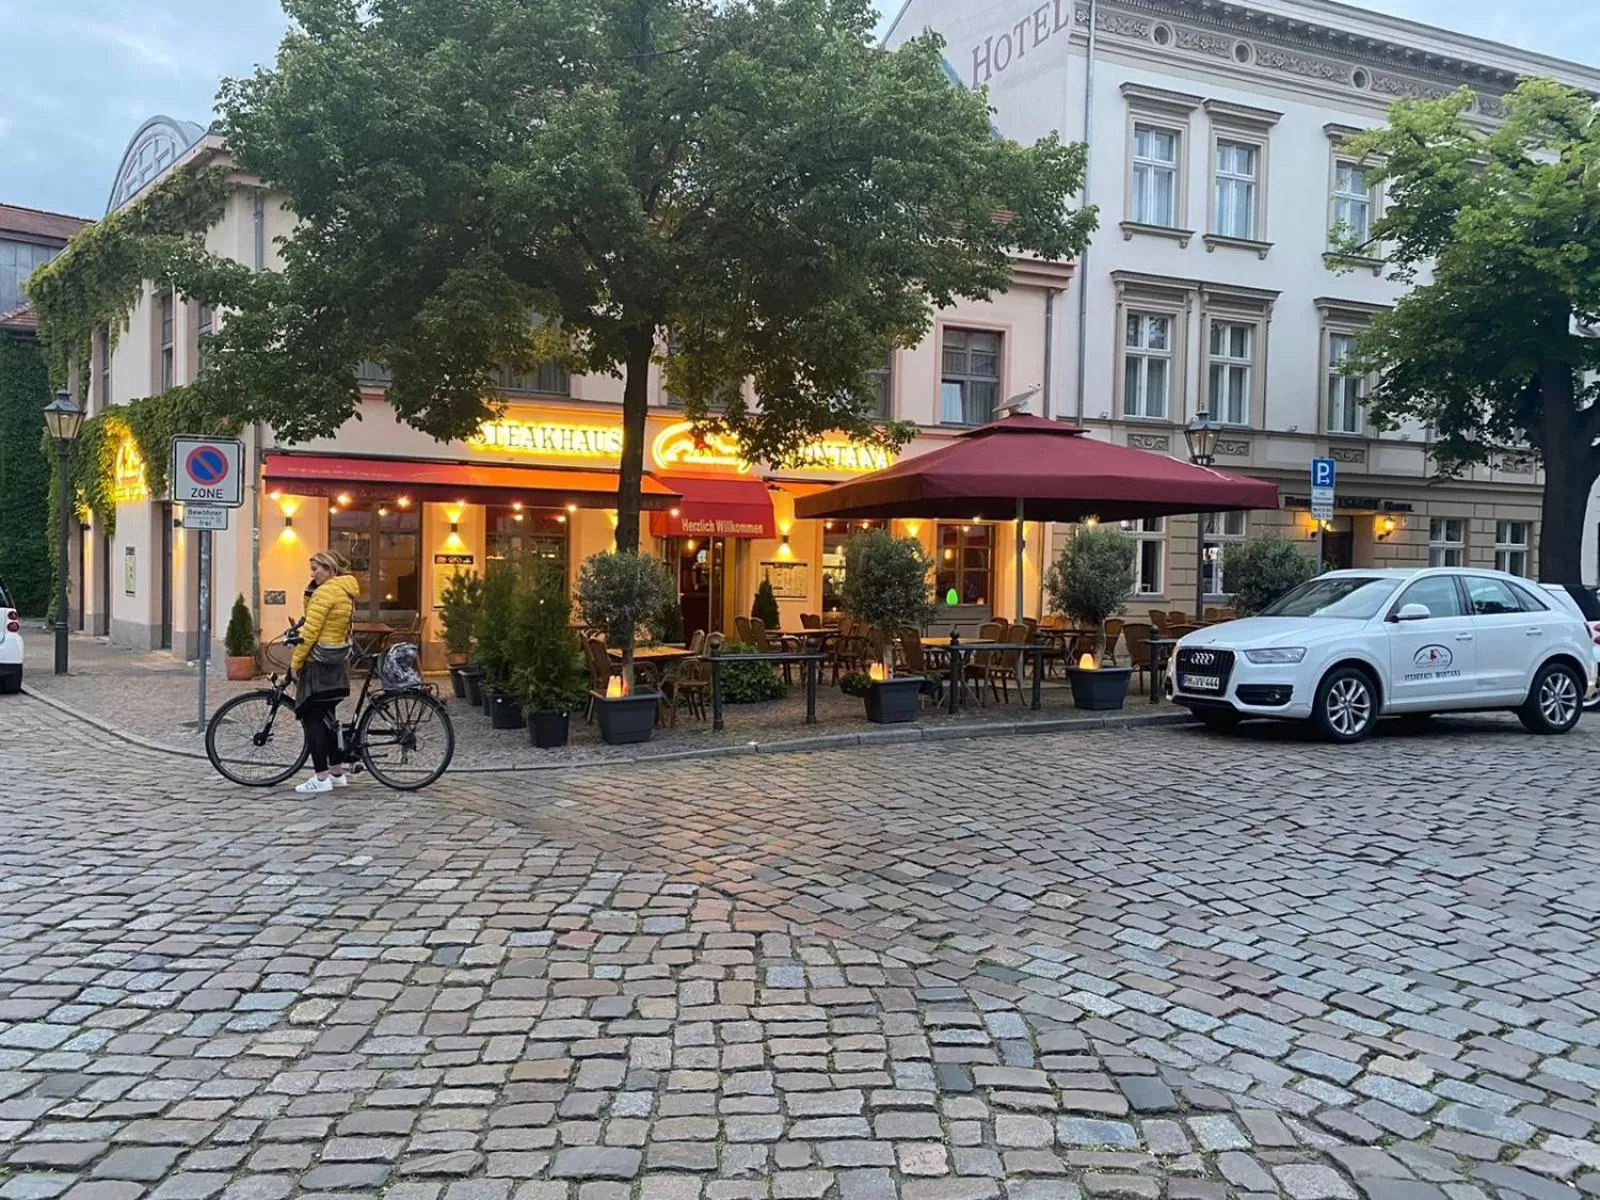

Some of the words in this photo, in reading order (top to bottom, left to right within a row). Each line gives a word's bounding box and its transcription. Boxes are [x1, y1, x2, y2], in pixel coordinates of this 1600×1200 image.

[972, 0, 1069, 90] HOTEL
[1316, 462, 1330, 485] P
[191, 488, 224, 499] ZONE
[187, 508, 223, 516] Bewohner
[682, 519, 715, 533] Herzlich
[715, 520, 764, 534] Willkommen
